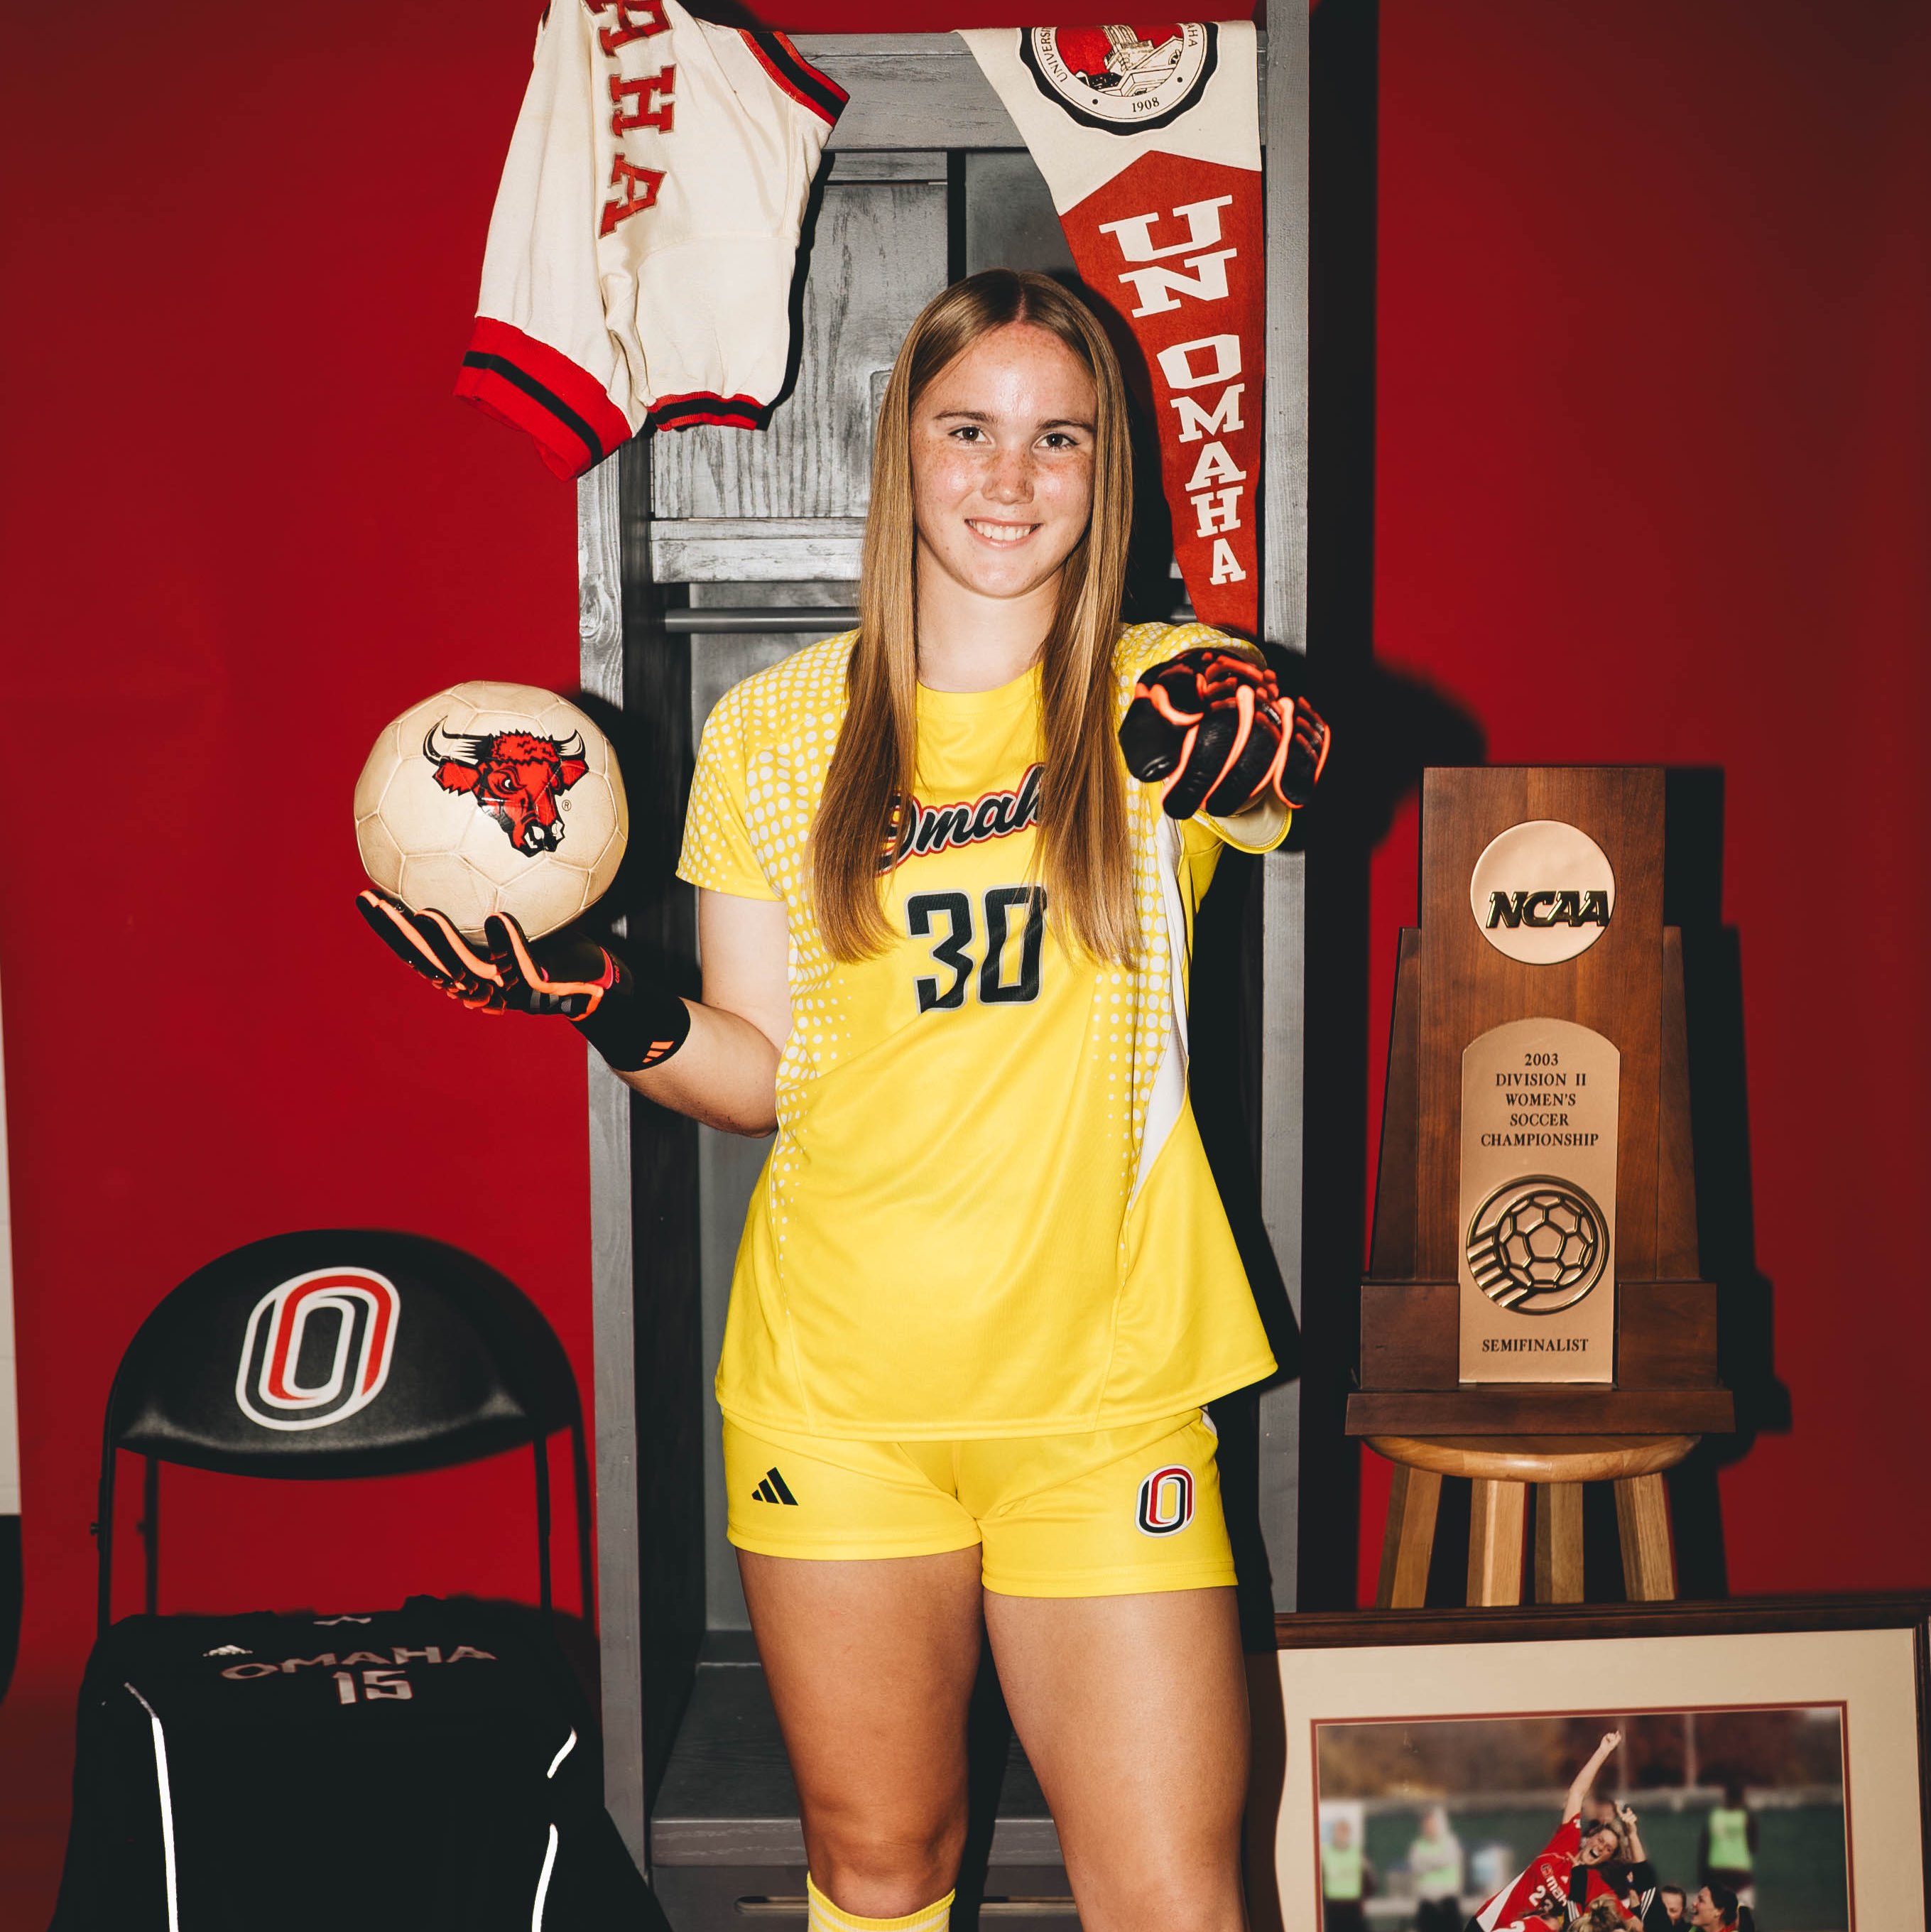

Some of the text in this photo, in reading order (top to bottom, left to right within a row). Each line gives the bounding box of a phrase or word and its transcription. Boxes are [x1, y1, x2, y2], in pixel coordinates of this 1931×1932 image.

[1132, 97, 1160, 112] 1908
[1156, 333, 1246, 585] OMAHA
[1486, 891, 1610, 928] NCAA
[904, 883, 1048, 1014] 30
[1525, 1053, 1558, 1065] 2003
[1496, 1073, 1587, 1086] DIVISION II
[1506, 1093, 1576, 1107] WOMEN'S
[1510, 1114, 1569, 1127] SOCCER
[1481, 1134, 1599, 1146] CHAMPIONSHIP
[1482, 1339, 1589, 1352] SEMIFINALIST
[220, 1646, 497, 1679] OMAHA
[332, 1671, 413, 1705] 15
